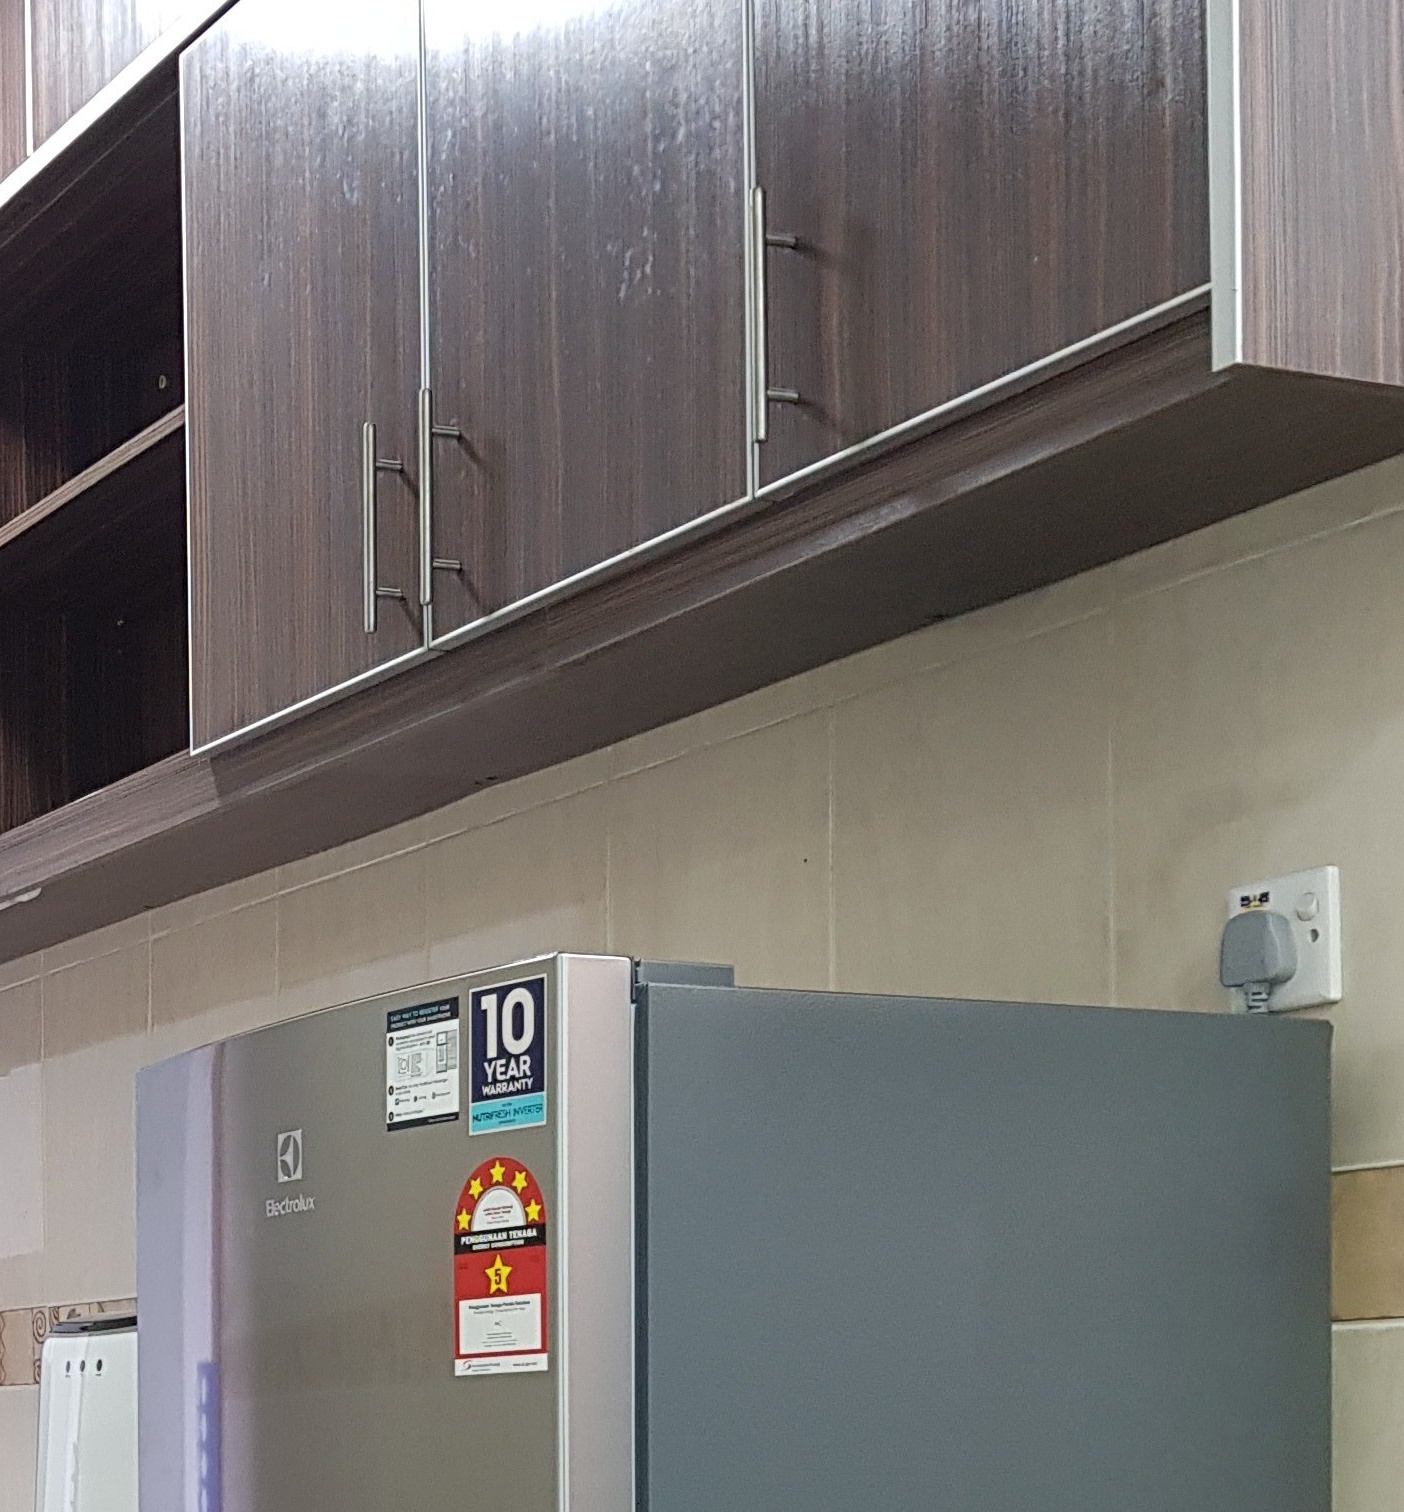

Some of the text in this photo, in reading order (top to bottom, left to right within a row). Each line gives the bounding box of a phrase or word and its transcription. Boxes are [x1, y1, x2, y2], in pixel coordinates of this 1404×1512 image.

[481, 987, 535, 1059] 10
[483, 1055, 532, 1083] YEAR
[481, 1077, 534, 1097] WARRANTY
[265, 1193, 316, 1217] Electrolux
[494, 1268, 502, 1286] 5
